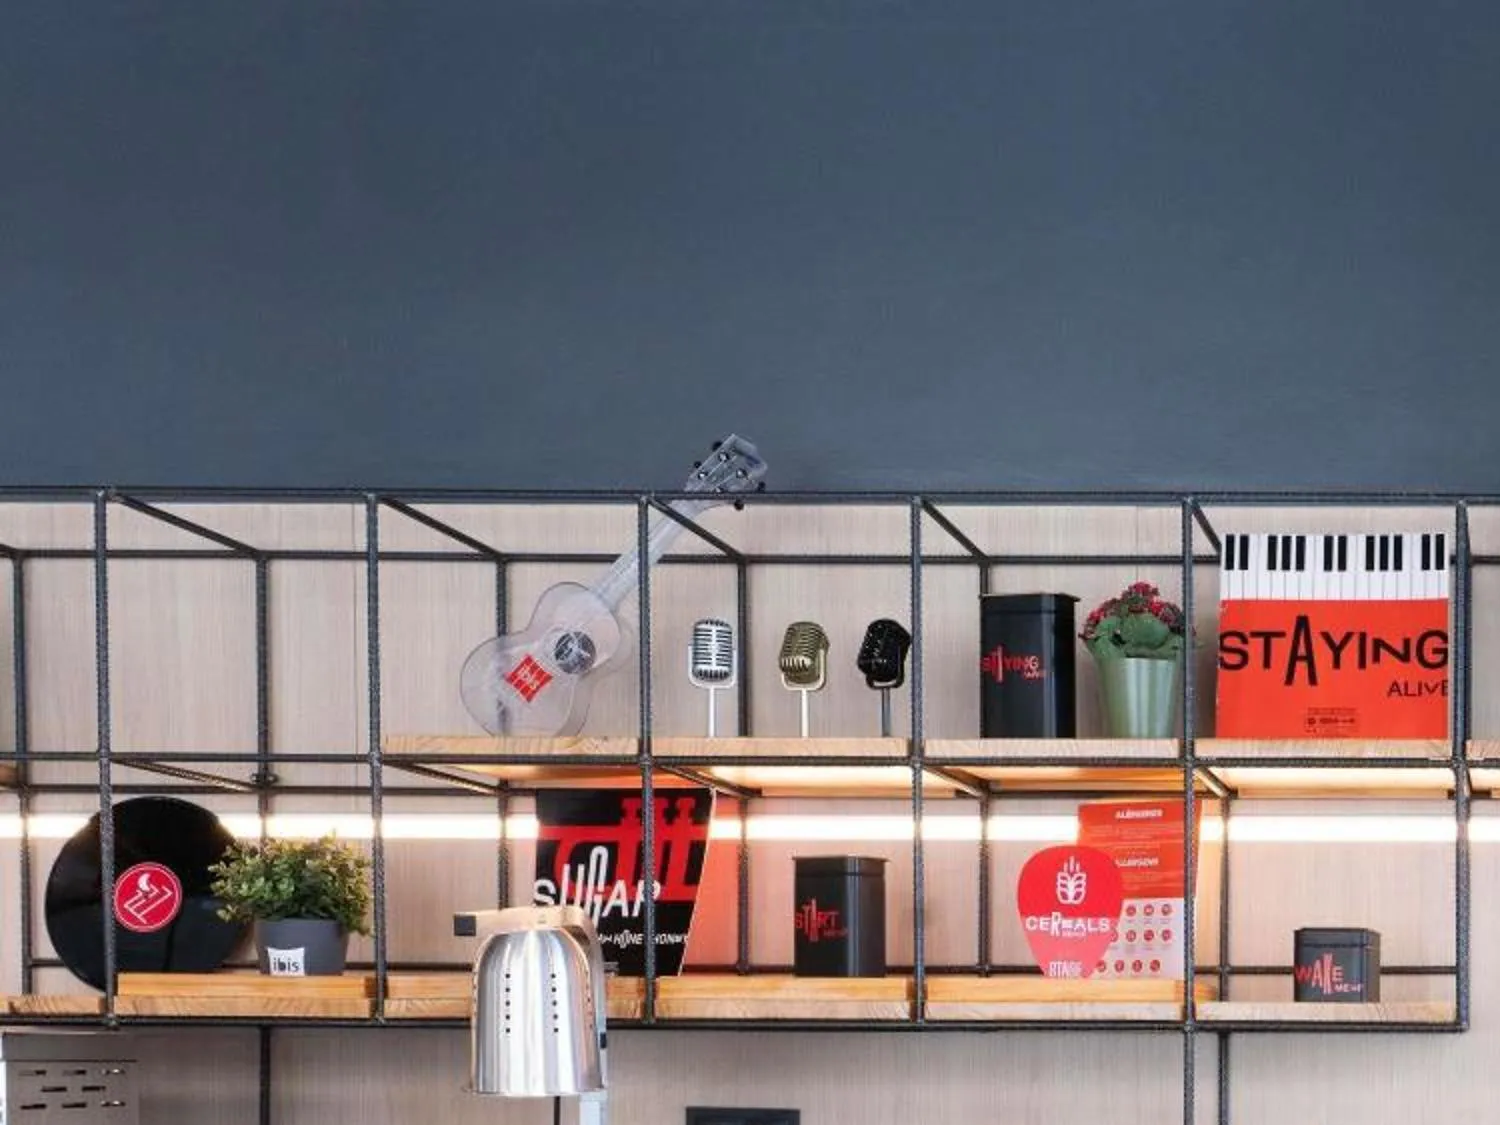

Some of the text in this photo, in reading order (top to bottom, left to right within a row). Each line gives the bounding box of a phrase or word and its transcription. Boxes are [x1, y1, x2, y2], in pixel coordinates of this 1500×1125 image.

[1219, 614, 1448, 686] STAYING
[1387, 679, 1448, 697] ALIVE
[273, 957, 300, 972] ibis
